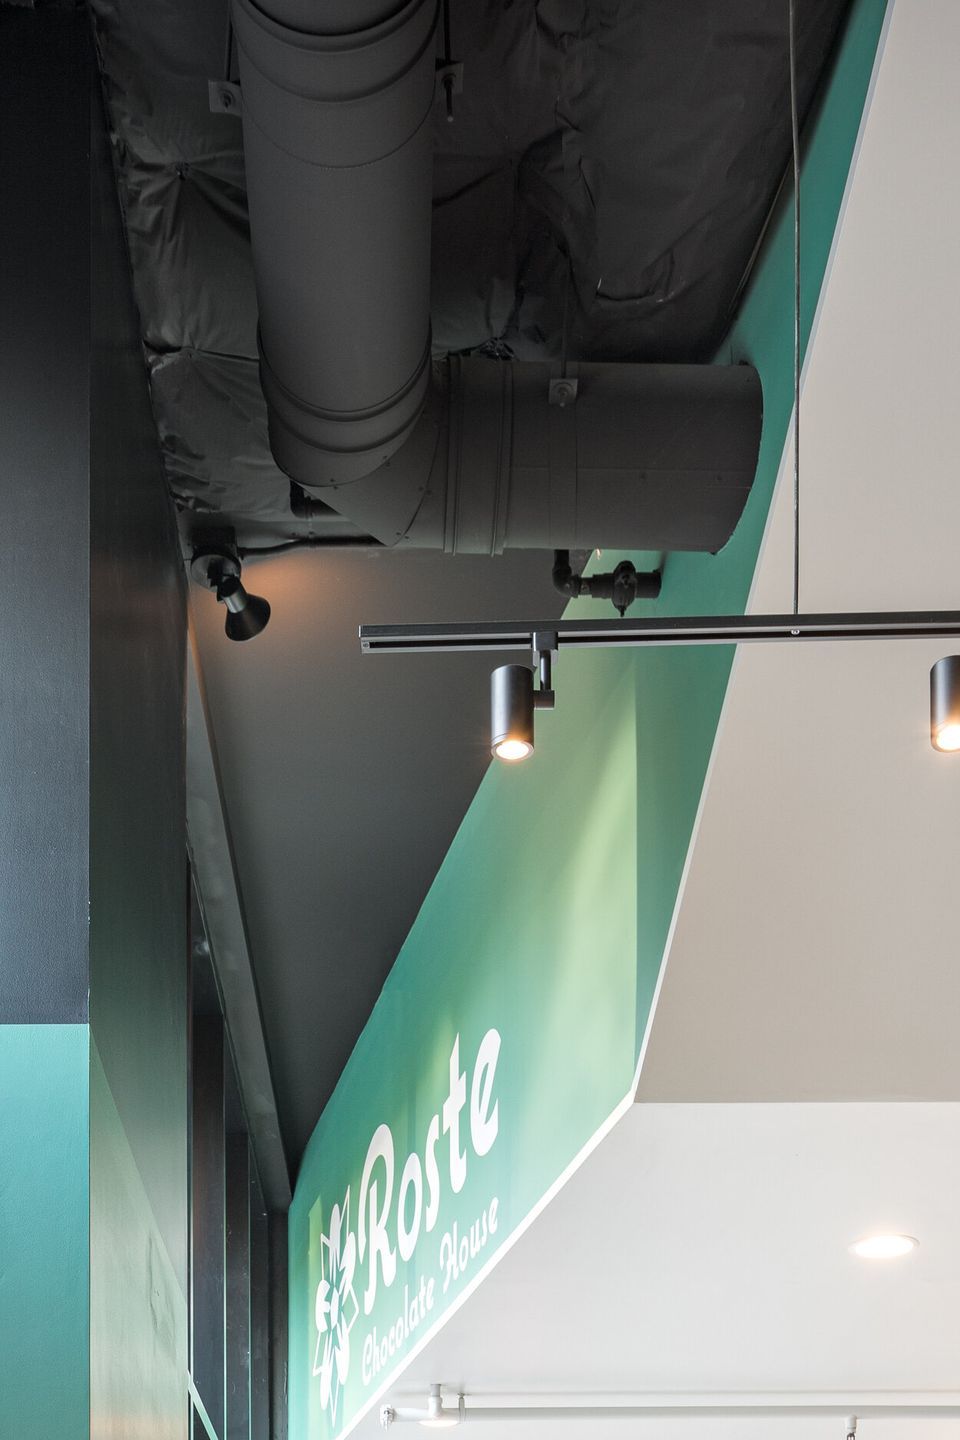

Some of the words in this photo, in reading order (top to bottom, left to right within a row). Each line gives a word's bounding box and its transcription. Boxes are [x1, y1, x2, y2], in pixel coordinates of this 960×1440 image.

[358, 1028, 502, 1316] Roste
[361, 1275, 436, 1387] Chocolate
[439, 1197, 500, 1295] House
